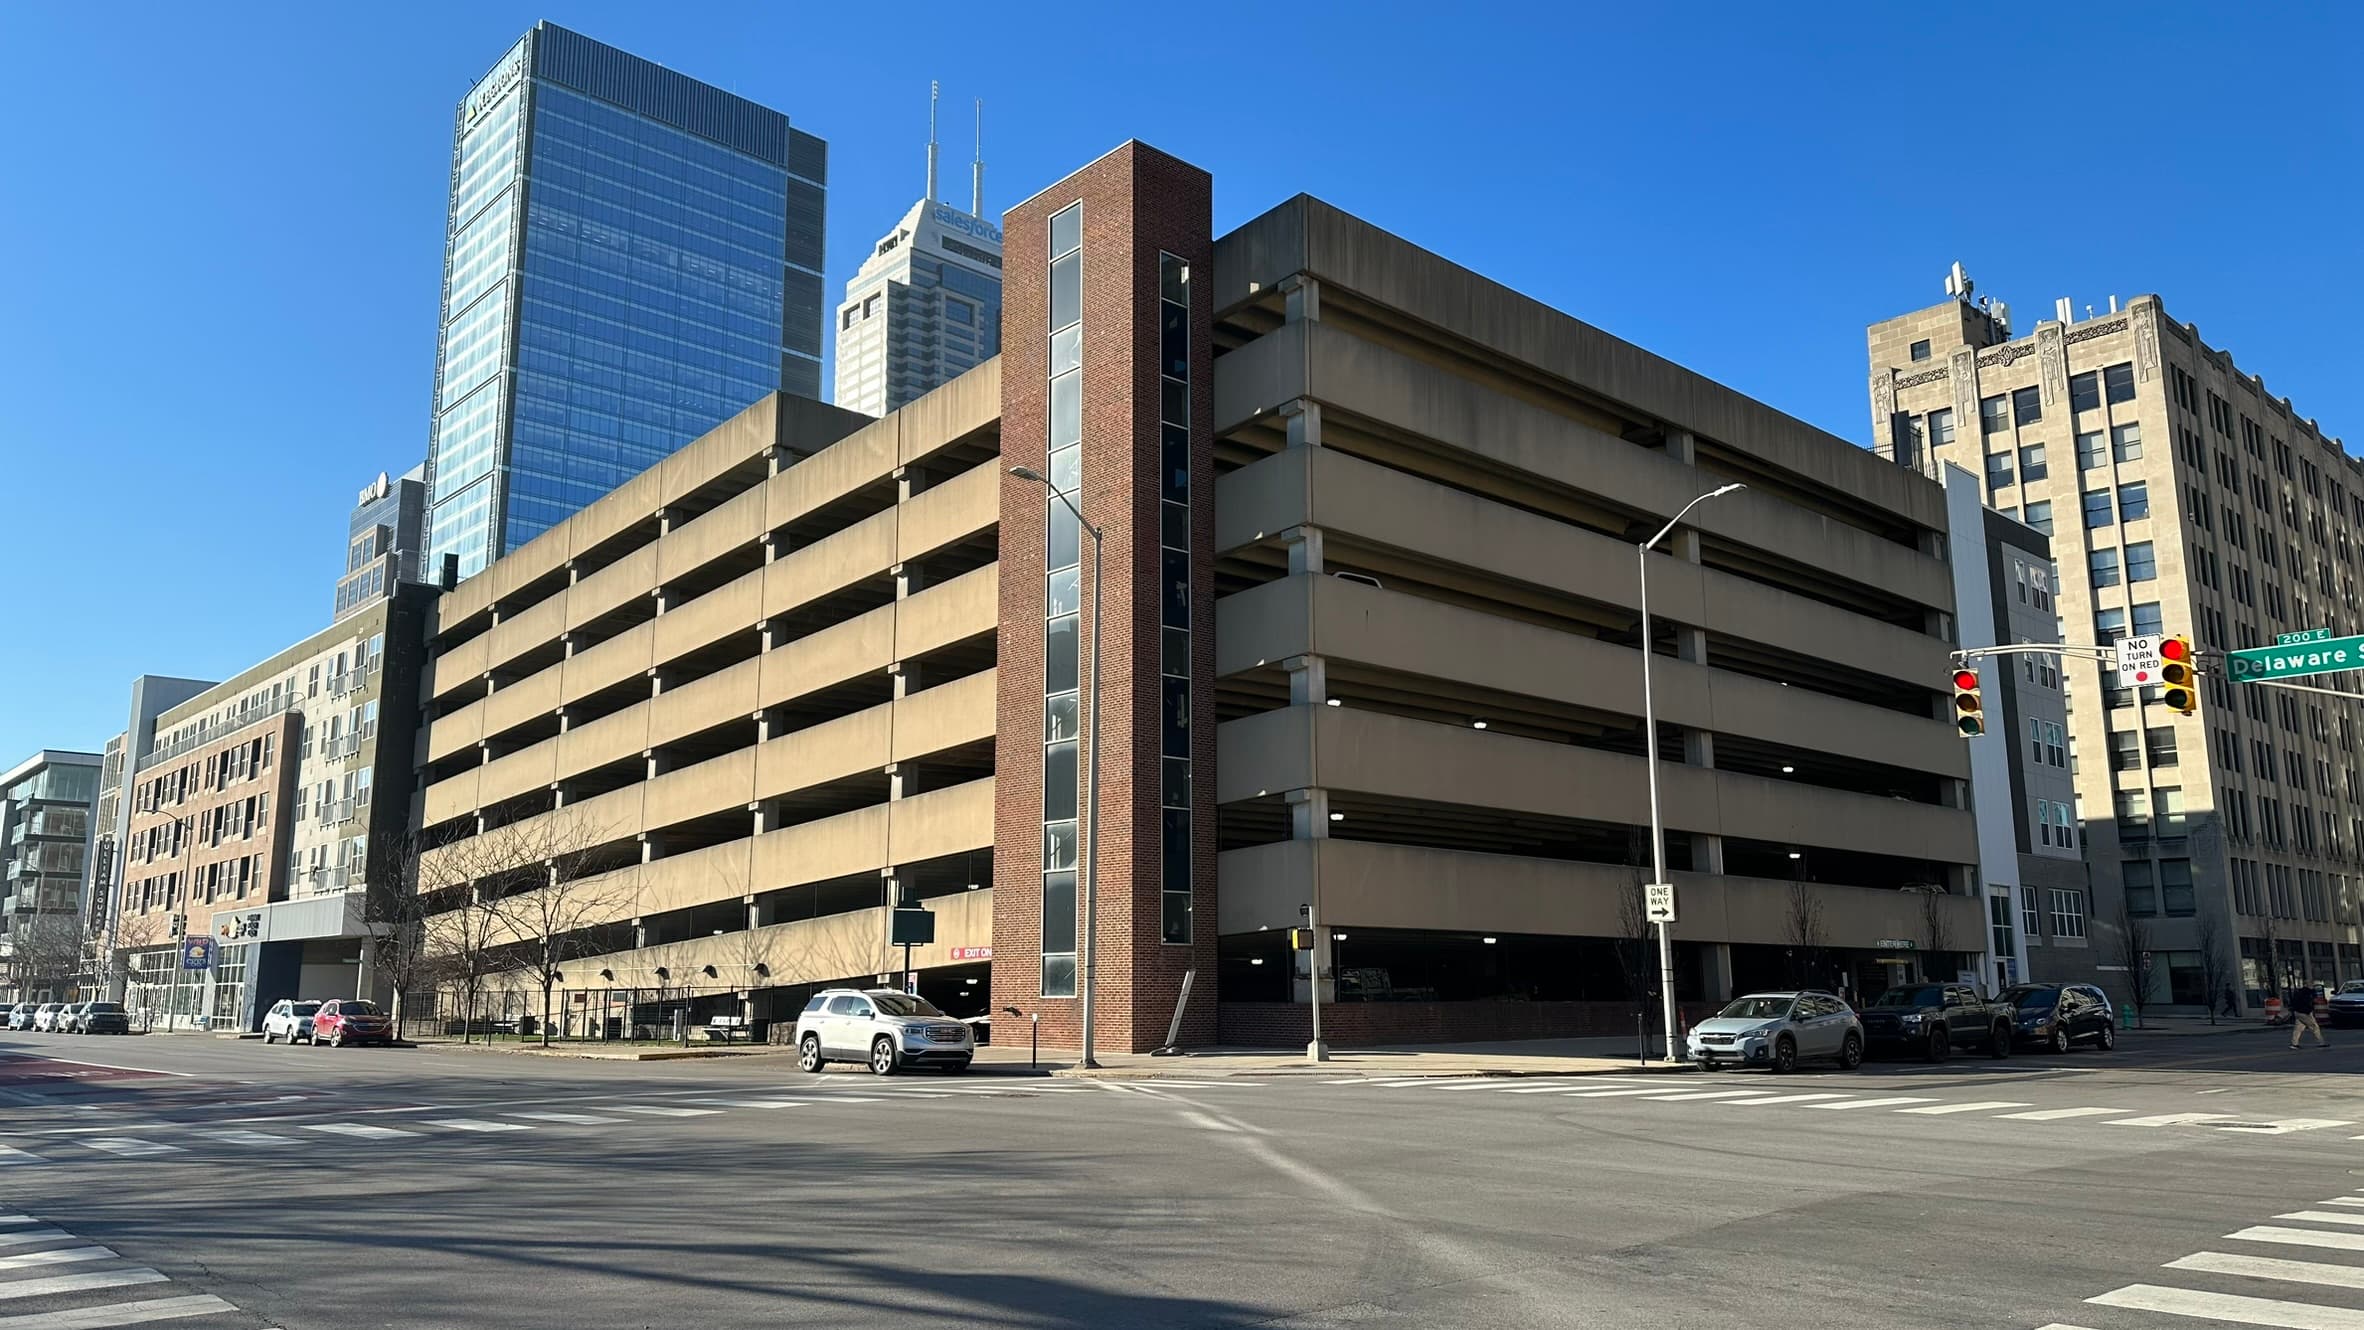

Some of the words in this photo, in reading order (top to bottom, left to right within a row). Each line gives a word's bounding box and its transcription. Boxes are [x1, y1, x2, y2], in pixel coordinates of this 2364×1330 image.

[935, 207, 1002, 243] salesforce
[2283, 632, 2311, 644] 200
[2317, 630, 2326, 639] E
[2128, 639, 2148, 651] NO
[2126, 650, 2153, 661] TURN
[2121, 662, 2136, 672] ON
[2139, 659, 2160, 670] RED
[2233, 649, 2347, 675] Delaware
[1650, 887, 1669, 896] ONE
[1650, 897, 1669, 906] WAY
[964, 948, 980, 958] EXIT
